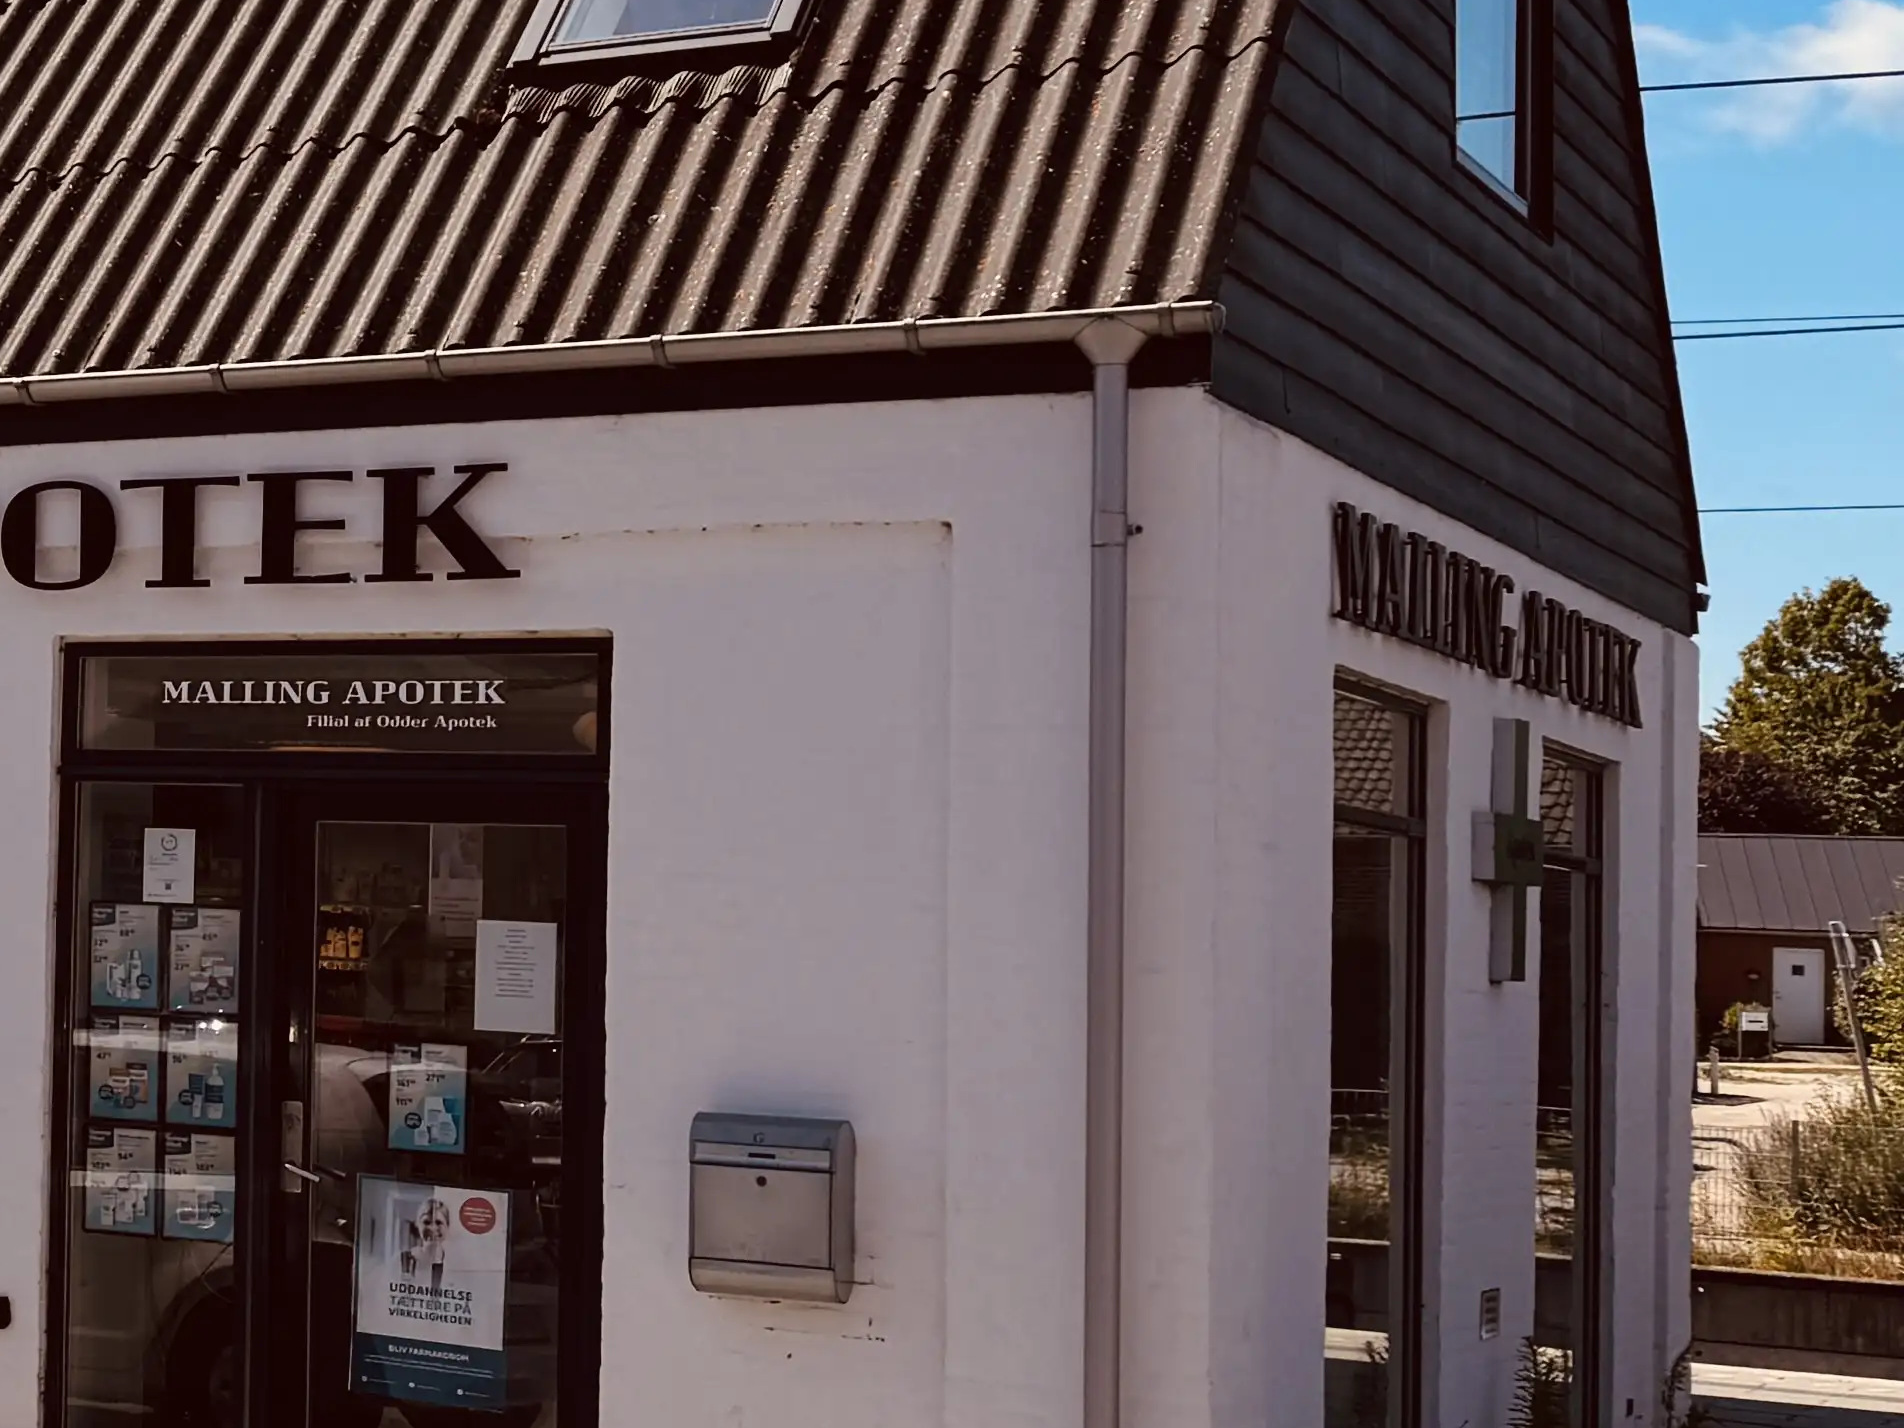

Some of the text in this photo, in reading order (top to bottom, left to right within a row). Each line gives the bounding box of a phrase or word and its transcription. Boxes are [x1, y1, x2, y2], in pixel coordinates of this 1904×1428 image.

[1330, 501, 1643, 729] MALLING APOTEK
[161, 679, 506, 705] MALLING APOTEK
[306, 714, 498, 732] Filial af Odder Apotek
[389, 1282, 473, 1301] UDDANNELSE
[389, 1295, 472, 1315] TÆTTERE PÅ
[388, 1307, 472, 1326] VIRKELIGHEDEN
